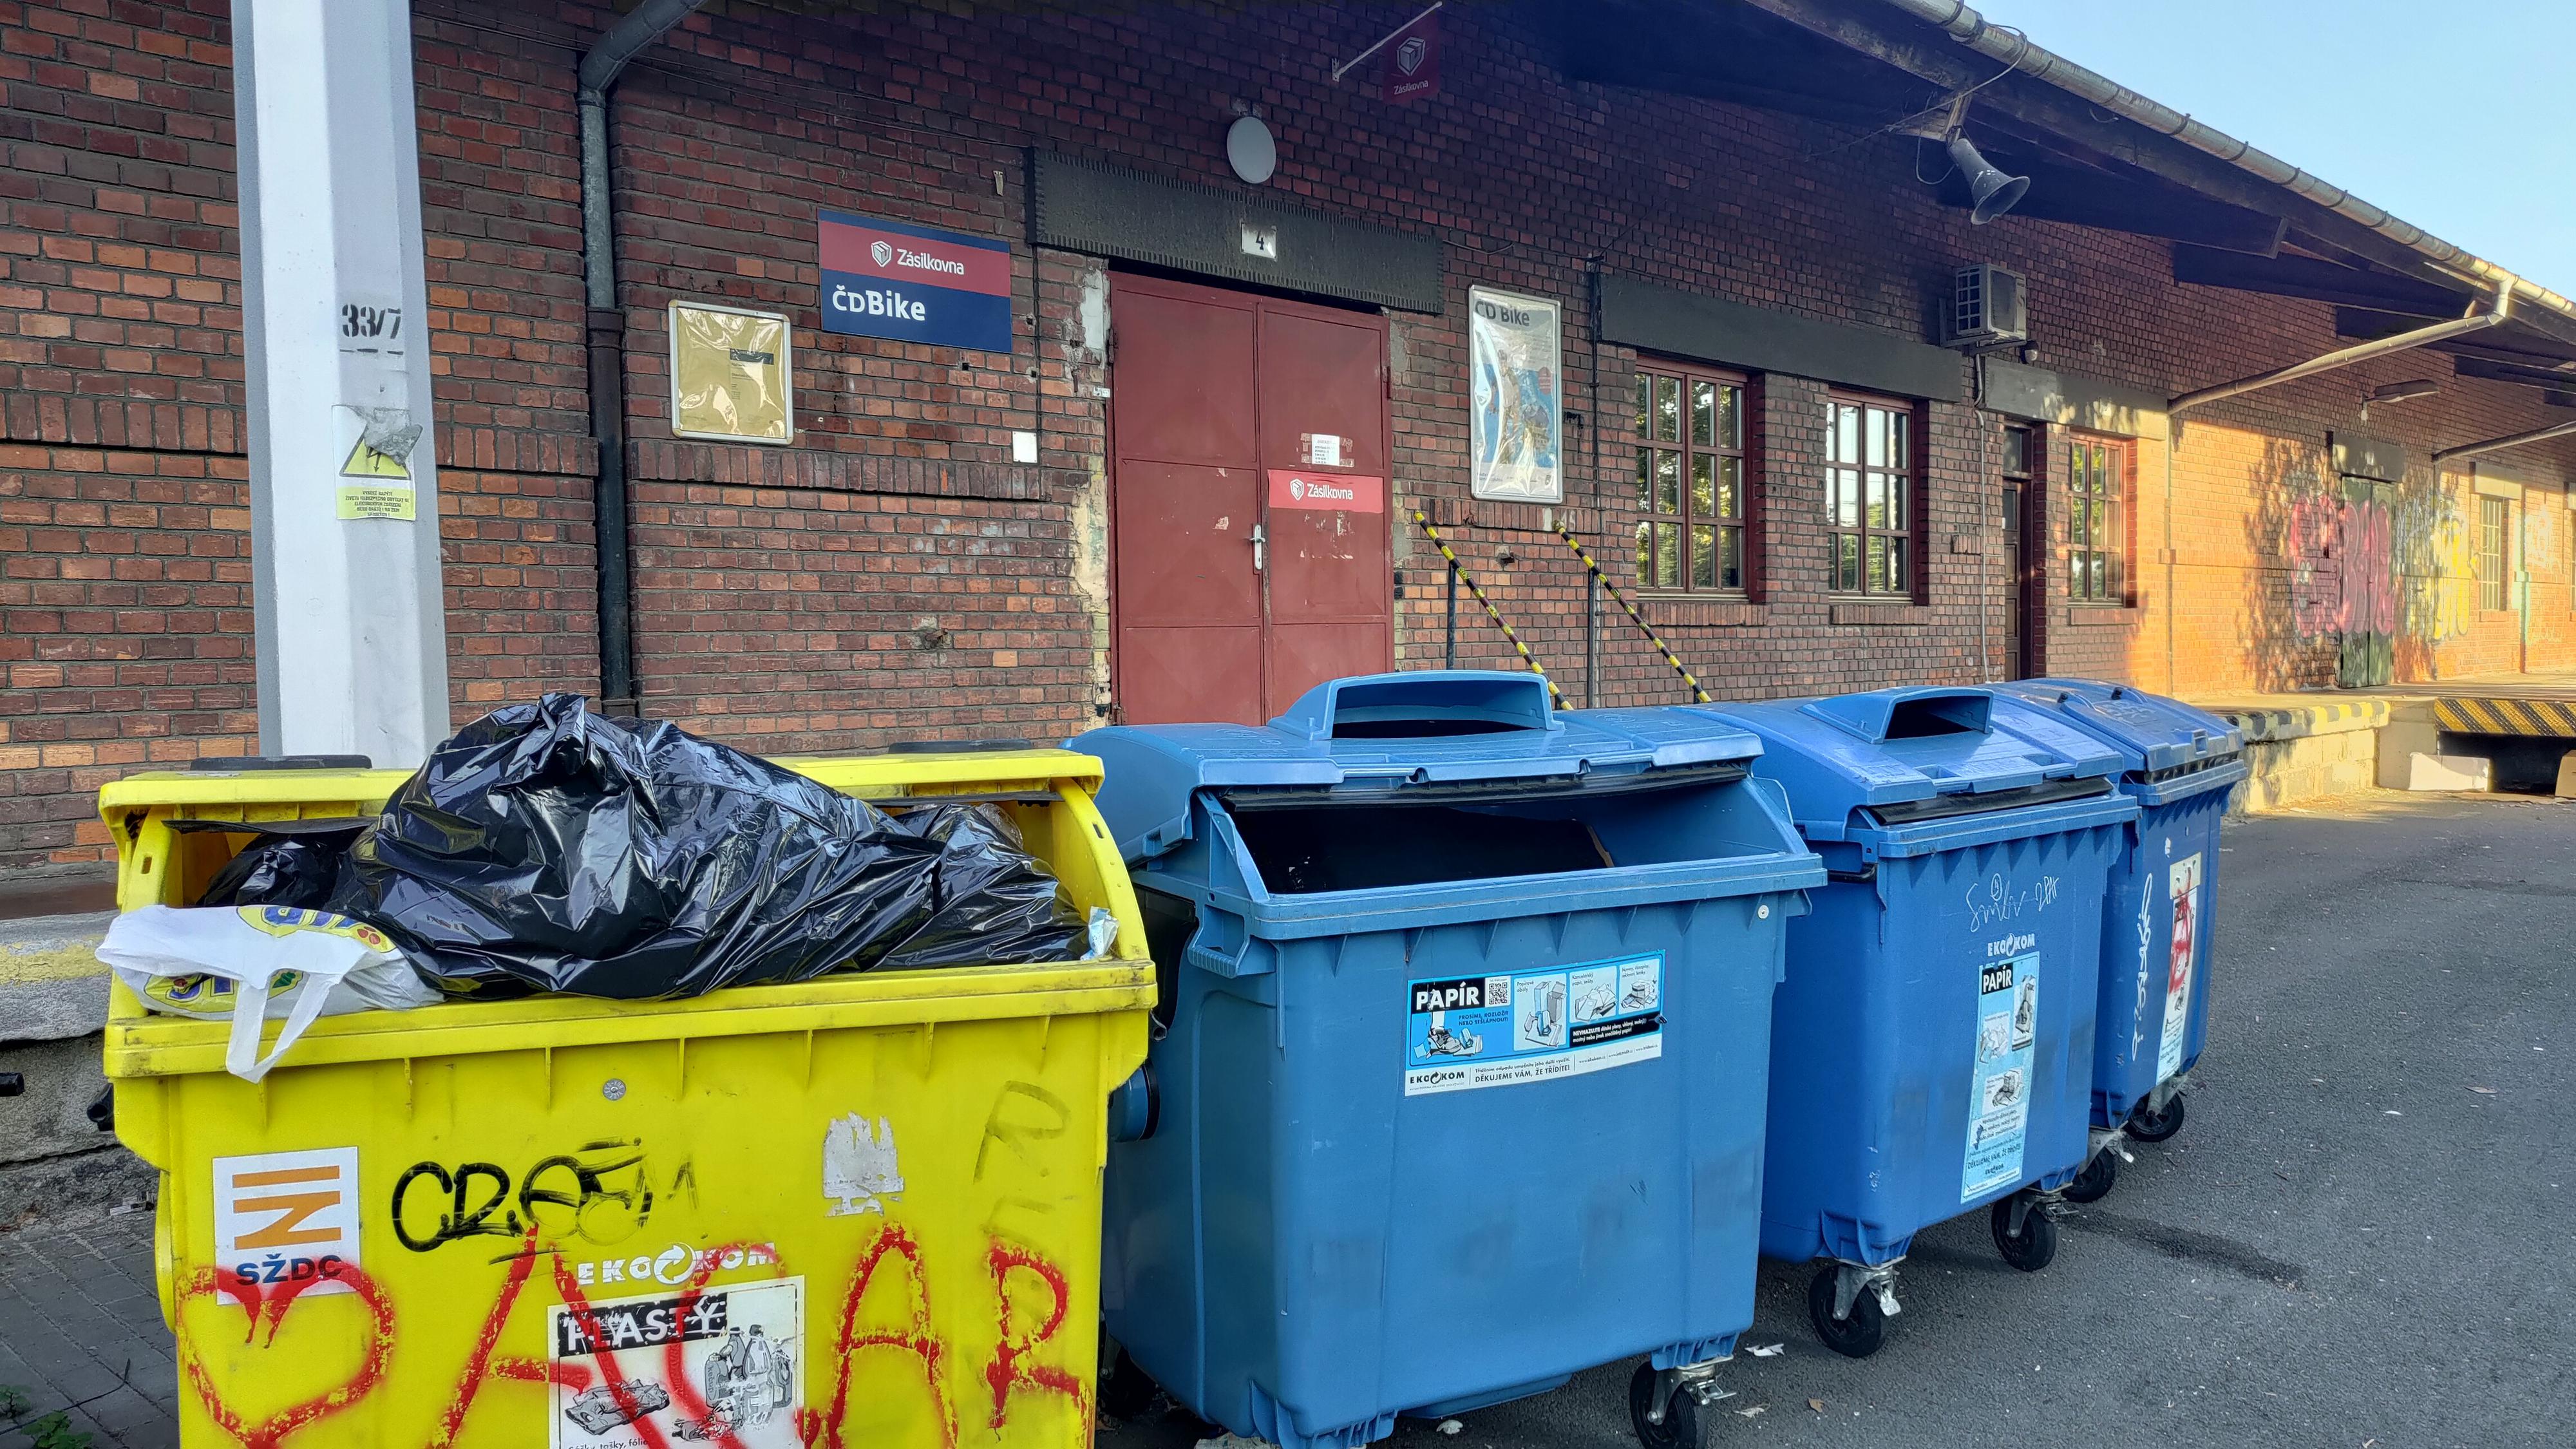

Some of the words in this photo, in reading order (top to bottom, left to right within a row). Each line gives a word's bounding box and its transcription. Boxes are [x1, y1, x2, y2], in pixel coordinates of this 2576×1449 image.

[1394, 80, 1428, 95] Zásilkovna
[1255, 229, 1265, 251] 4
[897, 248, 965, 276] Zásilkovna
[832, 284, 925, 321] ČDBike
[342, 303, 401, 339] 33/7
[1501, 307, 1530, 327] Bike
[1307, 483, 1354, 500] Zásilkovna
[1982, 965, 2012, 993] PAPÍR
[1416, 981, 1480, 1010] PAPÍR
[1475, 1072, 1513, 1083] DĚKUJEME
[1515, 1070, 1533, 1078] VÁM,
[1535, 1068, 1543, 1076] ŽE
[1545, 1064, 1570, 1074] TŘÍDÍTE!
[236, 1253, 343, 1285] SŽDC
[567, 1300, 721, 1351] PLASTY
